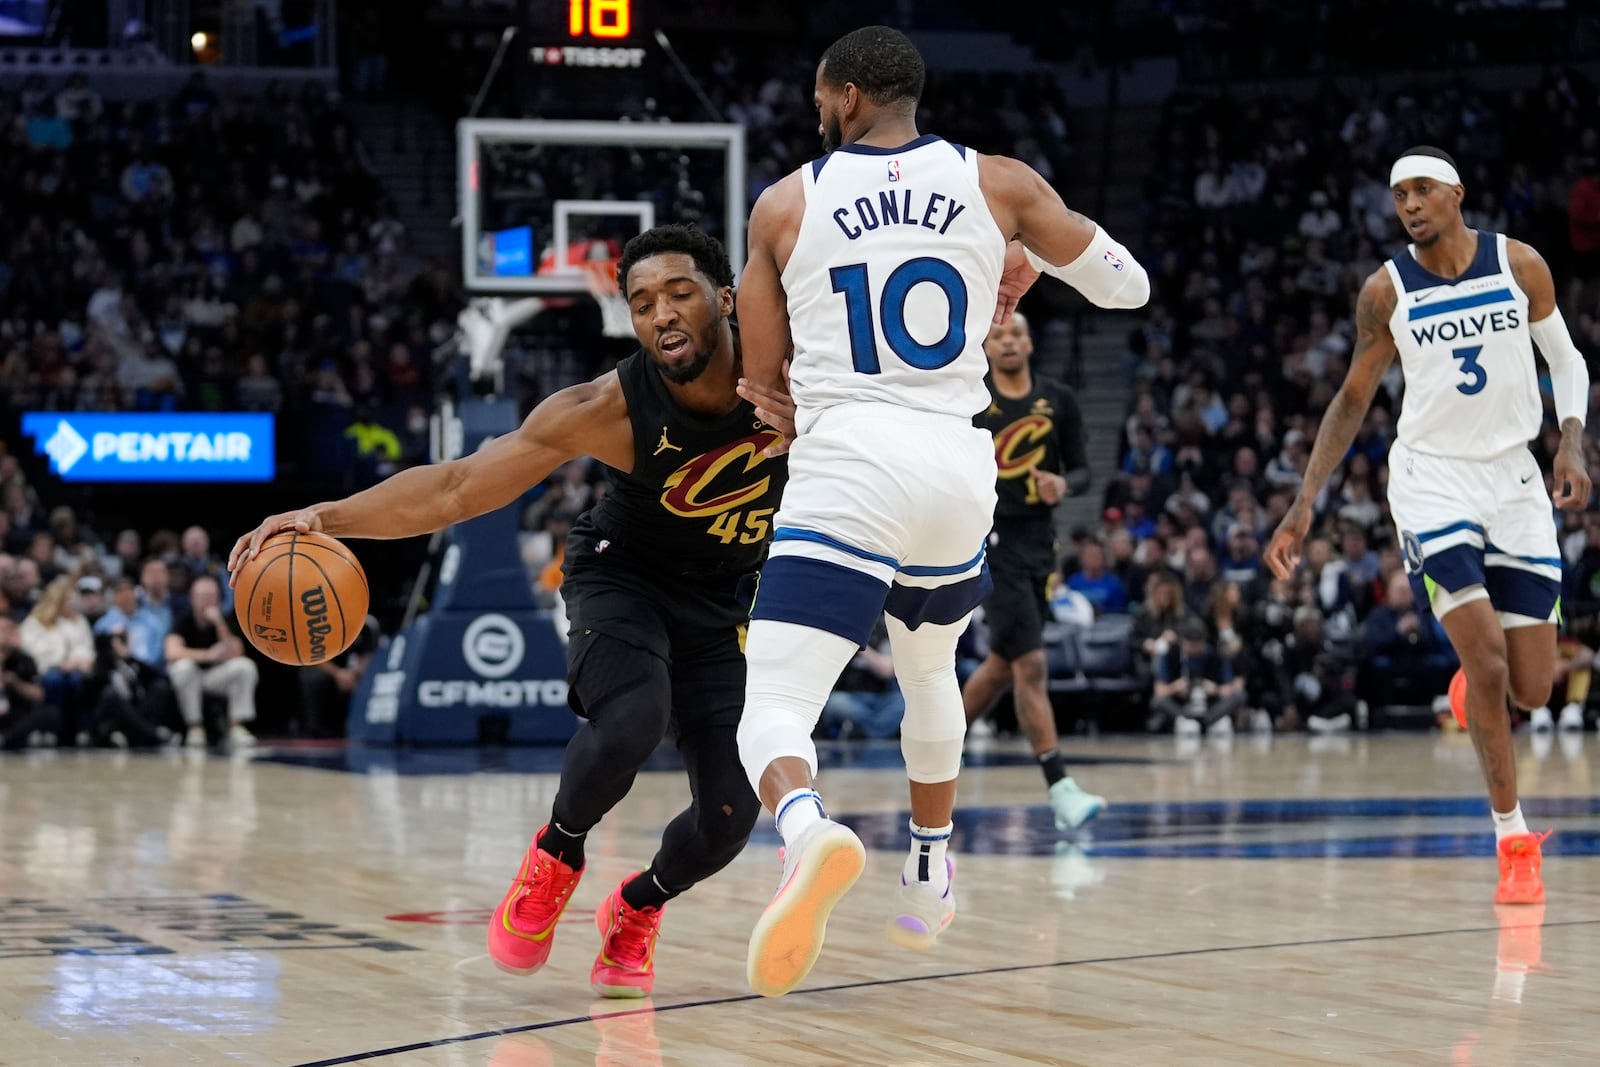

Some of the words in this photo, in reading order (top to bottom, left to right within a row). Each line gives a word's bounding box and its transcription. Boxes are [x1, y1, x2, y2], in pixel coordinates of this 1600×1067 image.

[568, 0, 630, 38] 18
[833, 189, 966, 240] CONLEY
[829, 256, 968, 374] 10
[1411, 309, 1520, 347] WOLVES
[1452, 344, 1487, 395] 3
[93, 431, 252, 462] PENTAIR
[706, 507, 774, 545] 45
[301, 584, 331, 662] Wilson
[418, 680, 568, 708] CFMOTO
